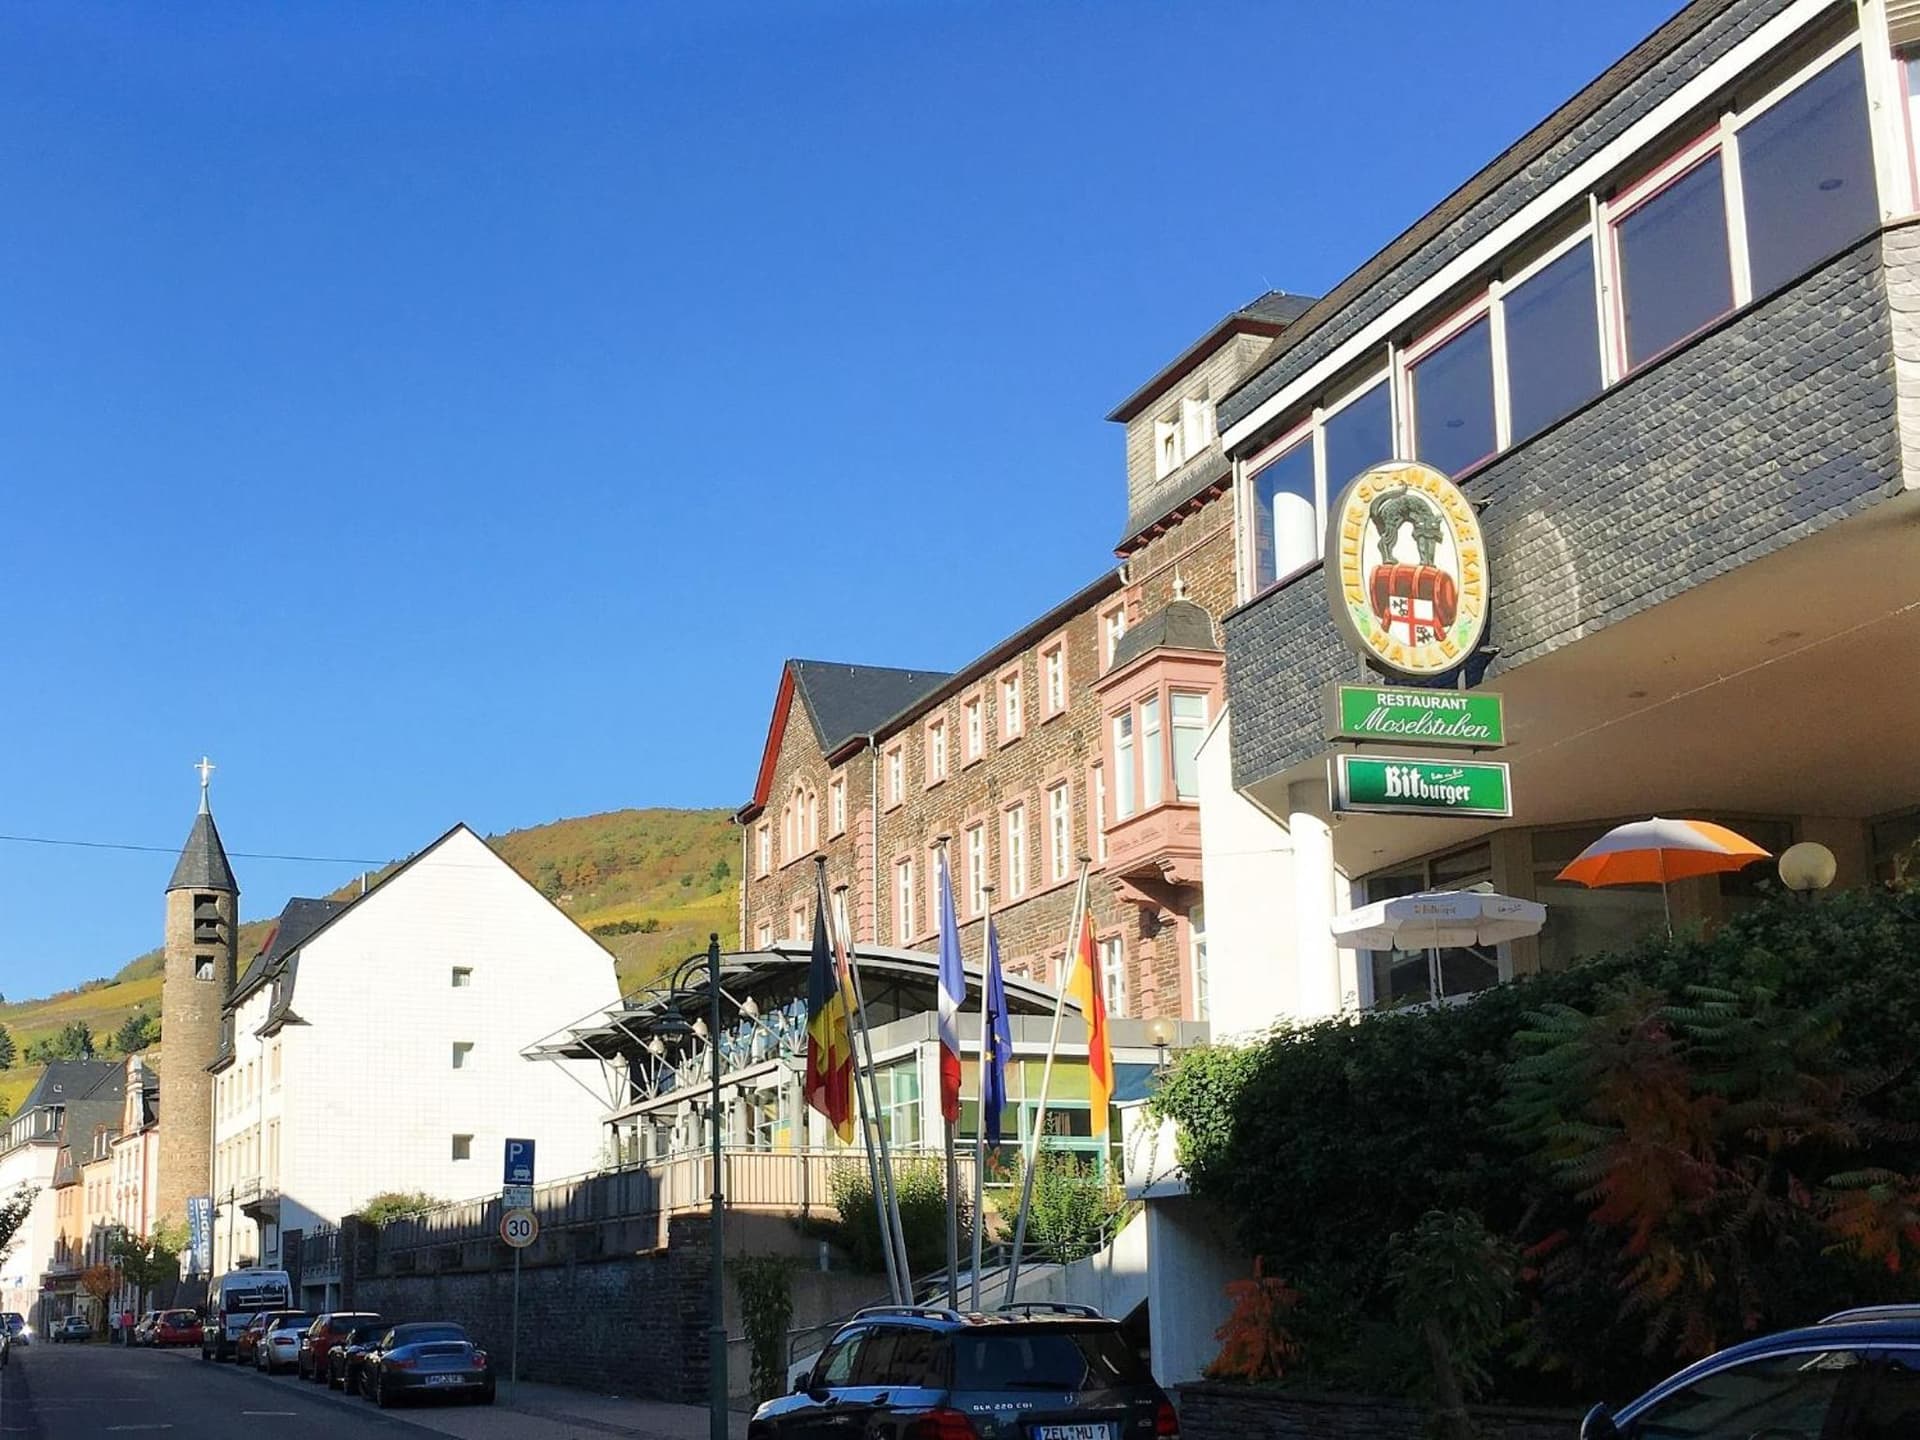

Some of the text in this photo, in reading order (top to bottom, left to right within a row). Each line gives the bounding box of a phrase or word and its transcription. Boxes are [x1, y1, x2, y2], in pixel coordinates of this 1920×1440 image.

[1370, 632, 1460, 670] HALLE
[1376, 692, 1468, 711] RESTAURANT
[1353, 706, 1491, 739] Moselstuben
[1384, 765, 1471, 805] Bitburger
[509, 1142, 524, 1163] P
[509, 1220, 530, 1237] 30
